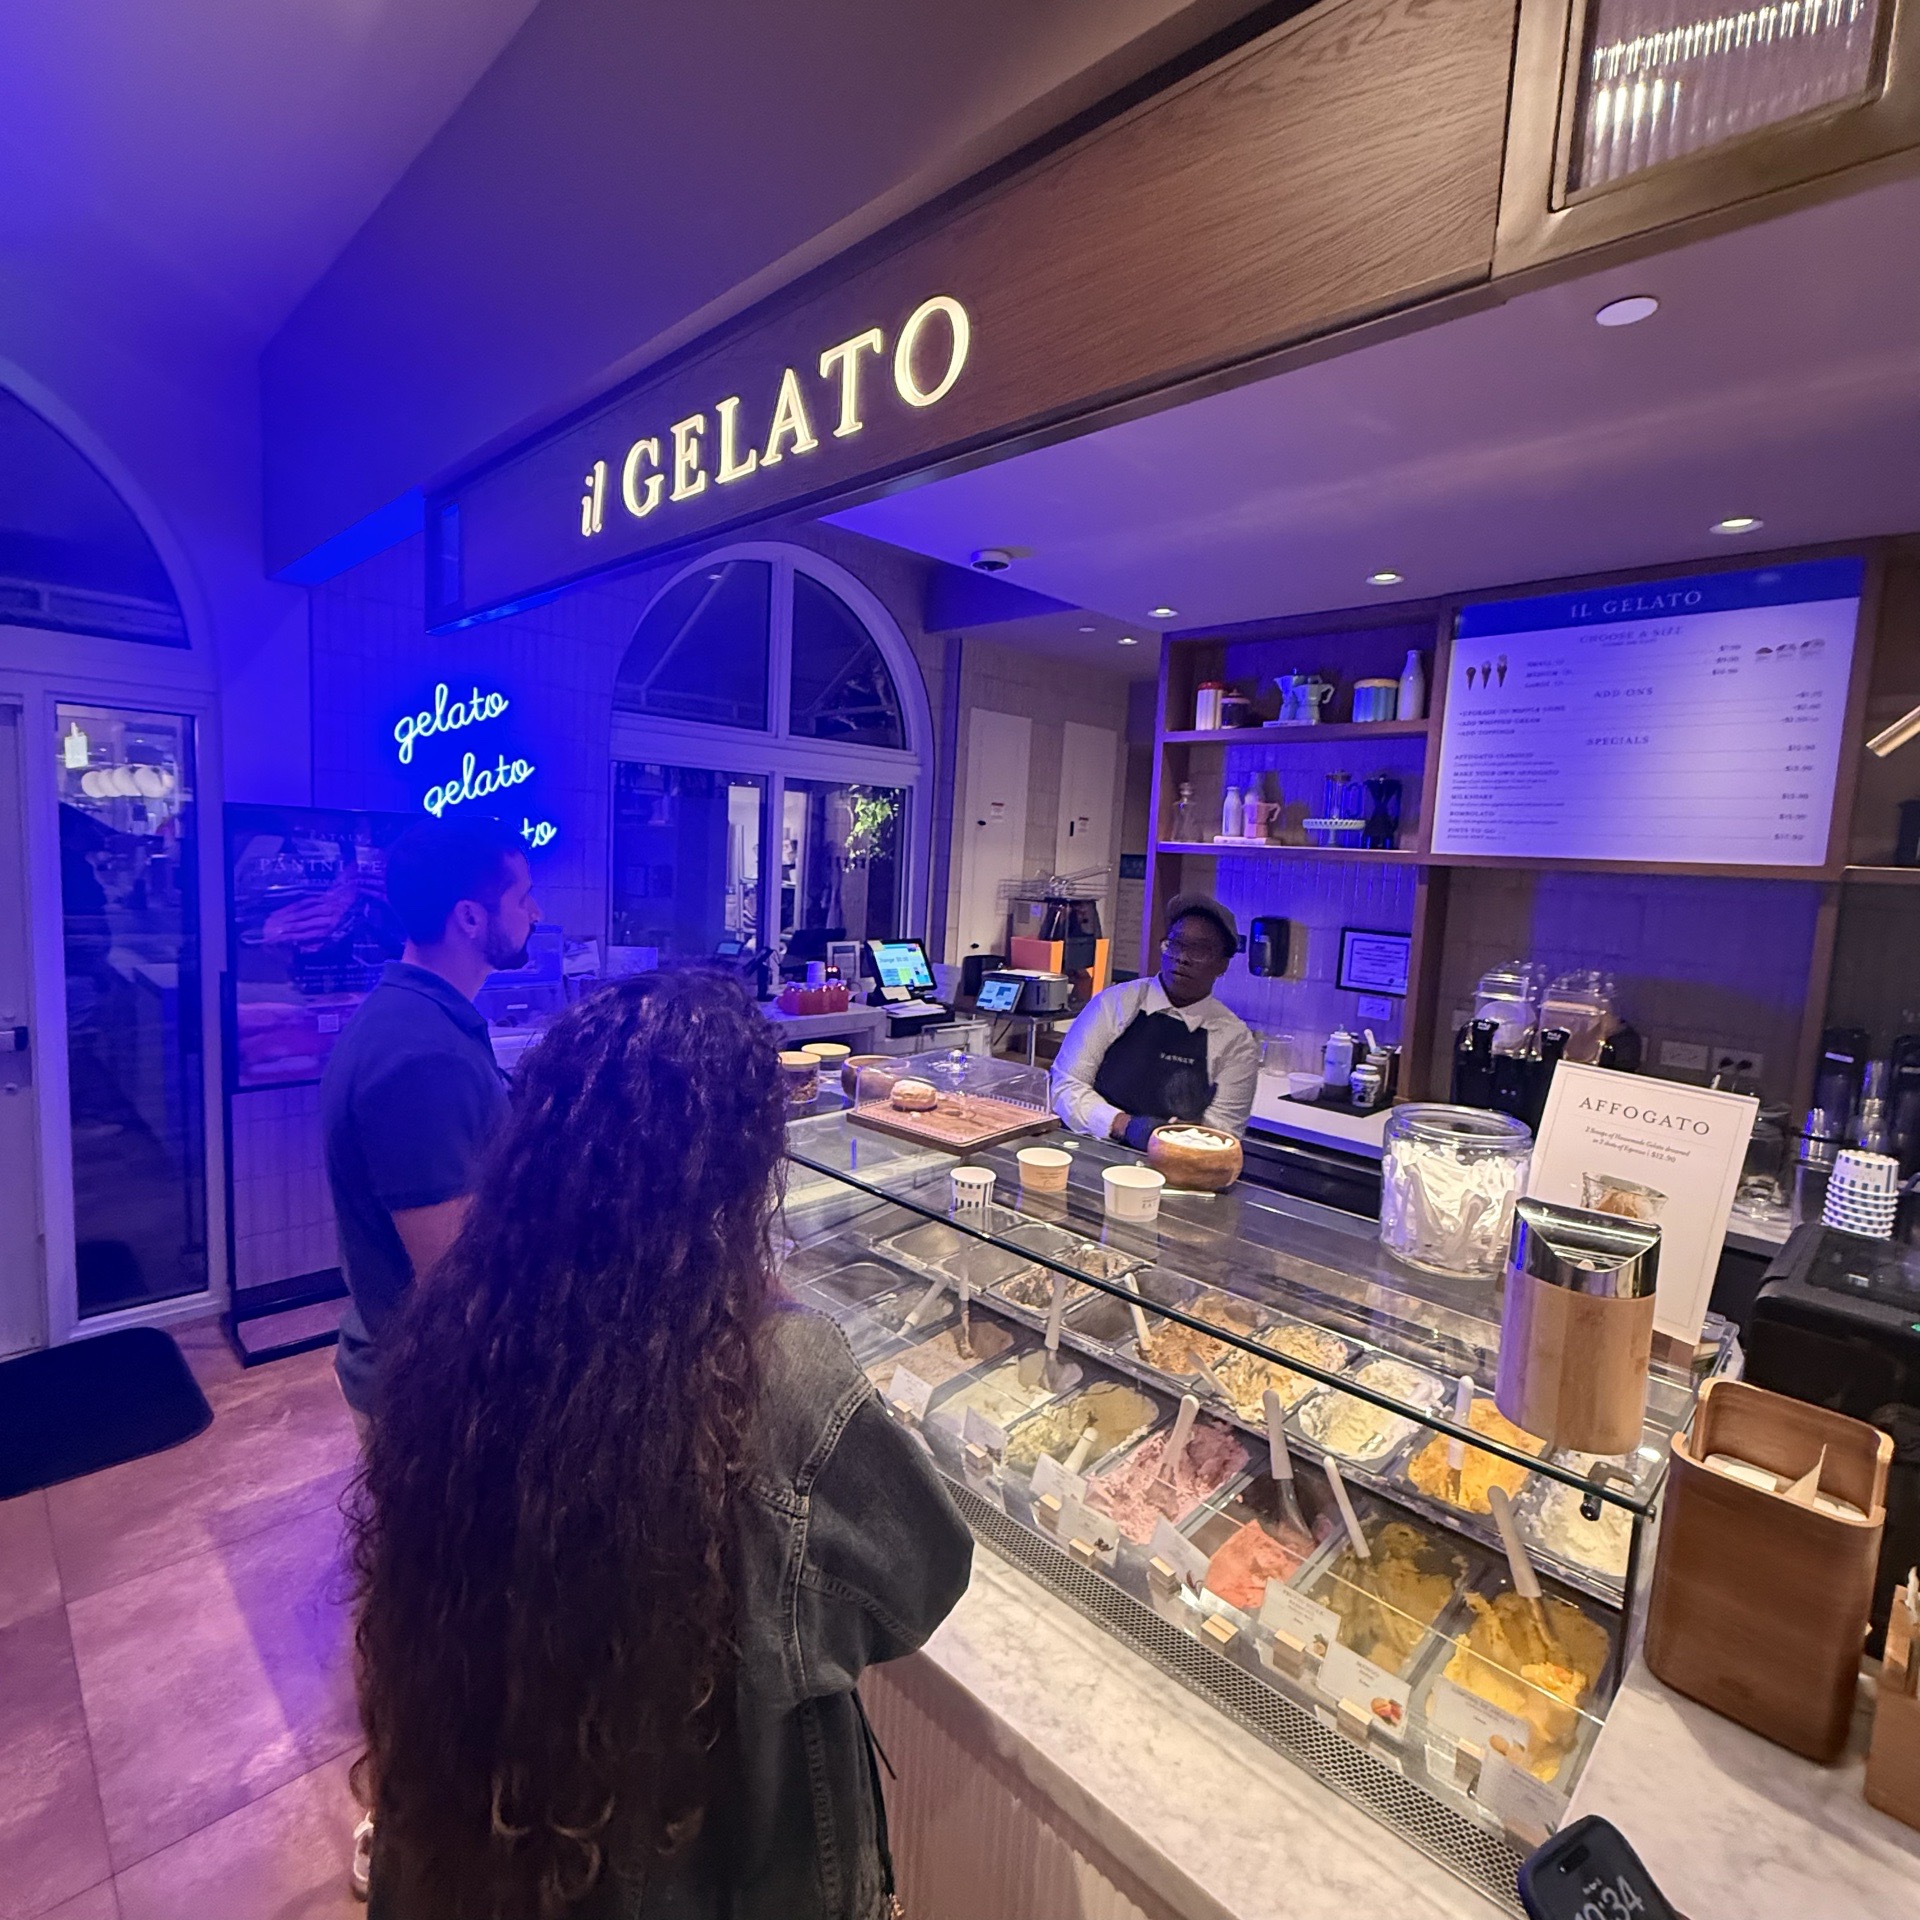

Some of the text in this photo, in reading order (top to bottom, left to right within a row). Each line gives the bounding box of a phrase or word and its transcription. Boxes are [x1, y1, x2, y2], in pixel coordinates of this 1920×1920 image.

[581, 294, 970, 537] il GELATO
[1571, 590, 1702, 618] IL GELATO
[1593, 687, 1653, 699] ADD ONS
[394, 683, 509, 764] gelato
[1587, 736, 1650, 746] SPECIALS
[259, 857, 345, 872] PANINI
[1578, 1097, 1710, 1135] AFFOGATO
[1646, 1141, 1664, 1150] Gelato
[1651, 1151, 1676, 1164] $12.90
